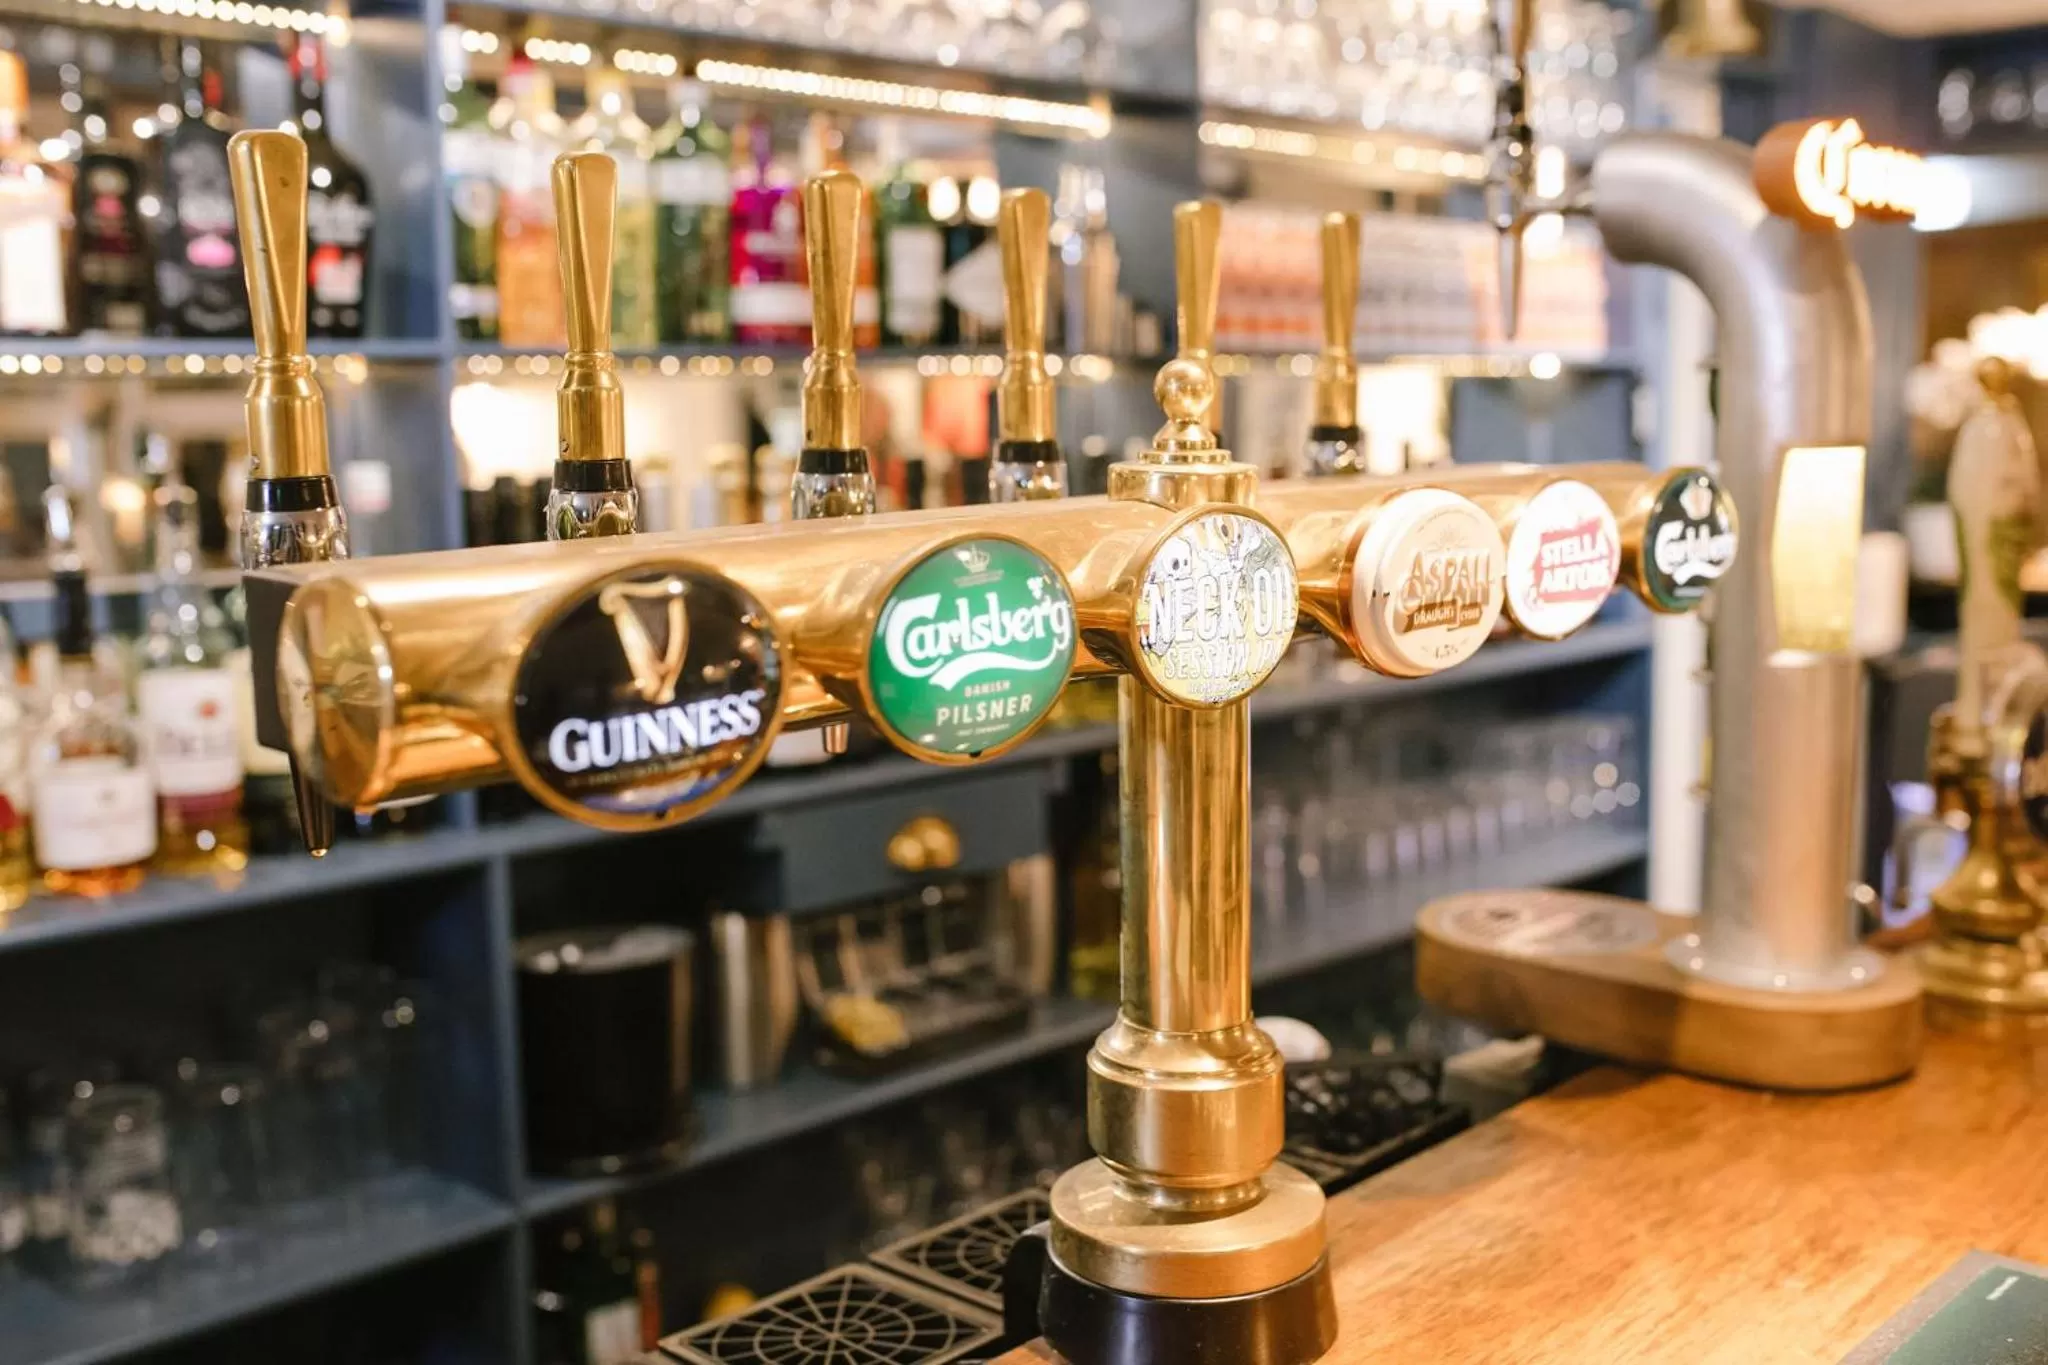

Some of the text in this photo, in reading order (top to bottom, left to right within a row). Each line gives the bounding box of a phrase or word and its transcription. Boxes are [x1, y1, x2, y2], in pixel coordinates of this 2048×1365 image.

[885, 591, 1072, 682] Carlsberg
[1147, 574, 1244, 644] NECK
[548, 689, 766, 773] GUINNESS
[936, 693, 1033, 727] PILSNER
